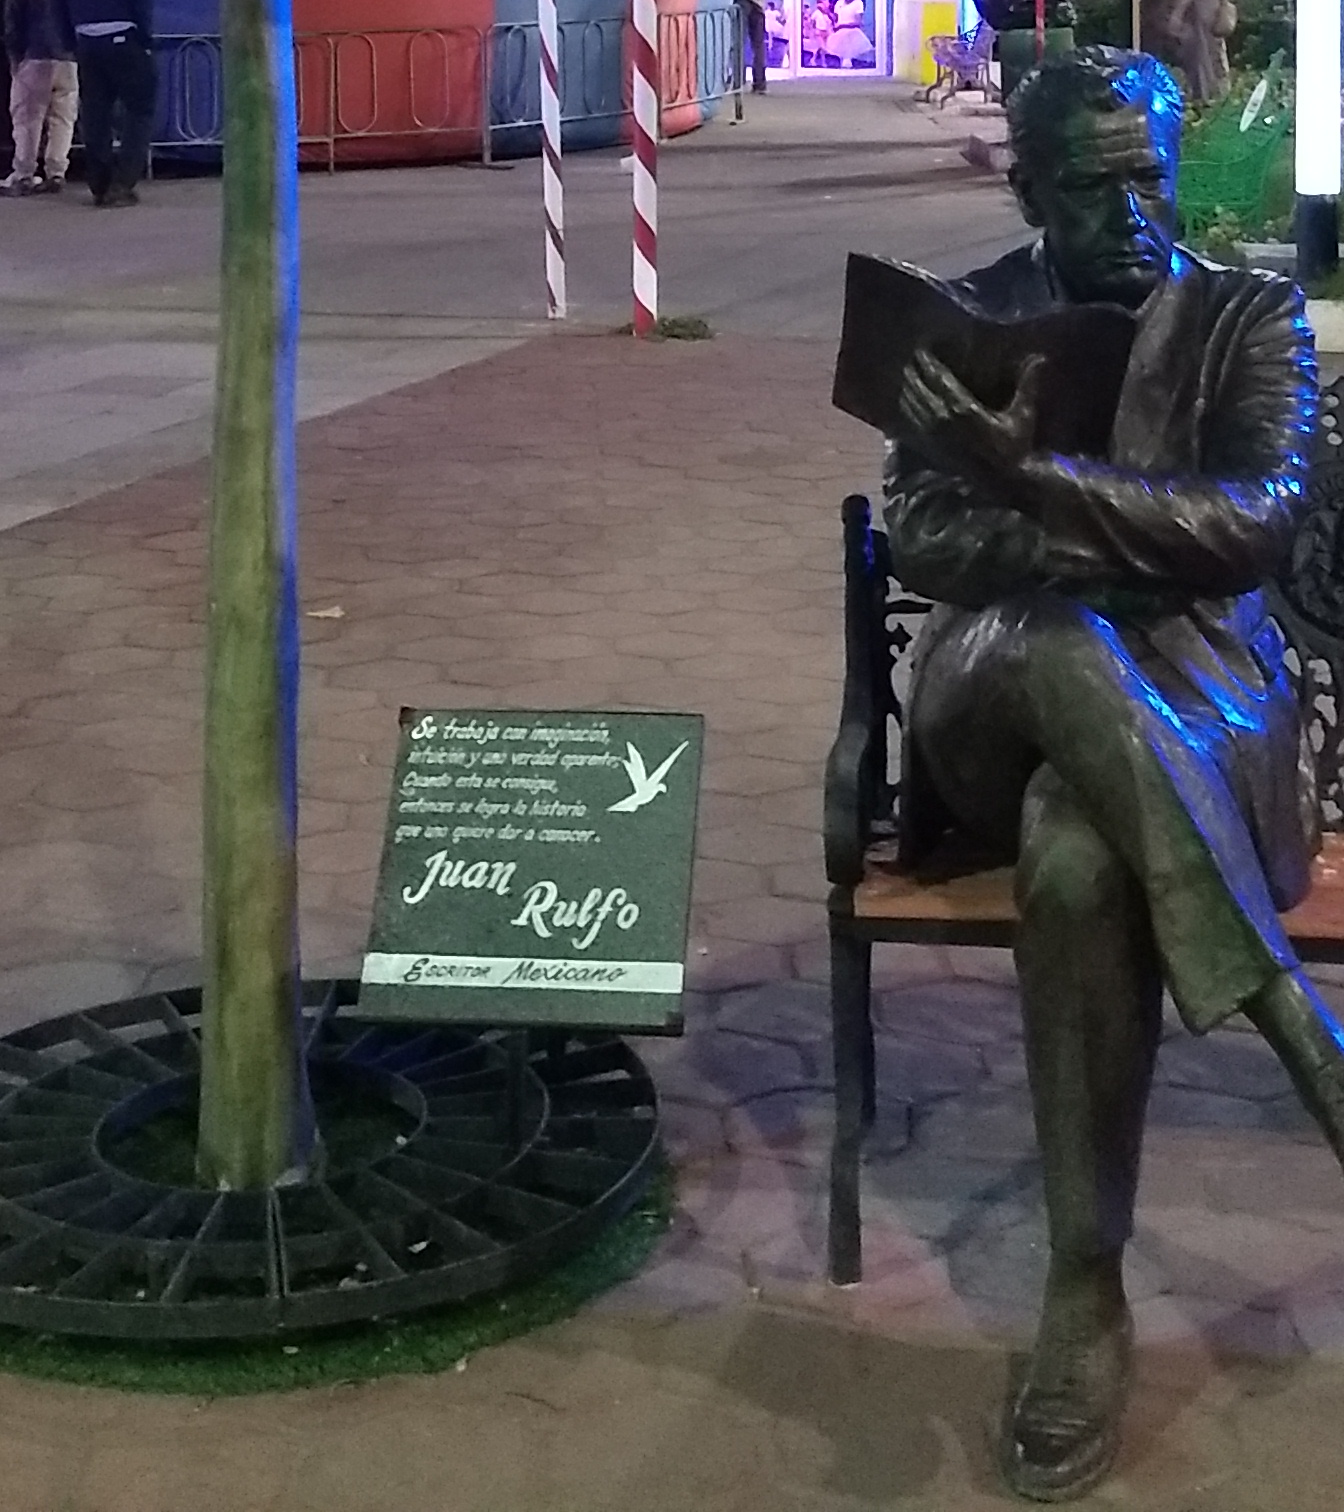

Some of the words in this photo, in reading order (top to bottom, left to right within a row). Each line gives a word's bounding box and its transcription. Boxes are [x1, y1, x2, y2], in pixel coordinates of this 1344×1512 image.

[411, 715, 437, 739] Se
[443, 718, 500, 744] trabaja
[464, 752, 481, 769] y
[483, 777, 501, 788] se
[456, 802, 474, 814] se
[511, 799, 528, 816] la
[528, 799, 587, 817] historia
[497, 823, 523, 839] dar
[402, 850, 517, 904] Juan
[510, 880, 640, 950] Rulfo
[500, 961, 628, 985] Mexicano
